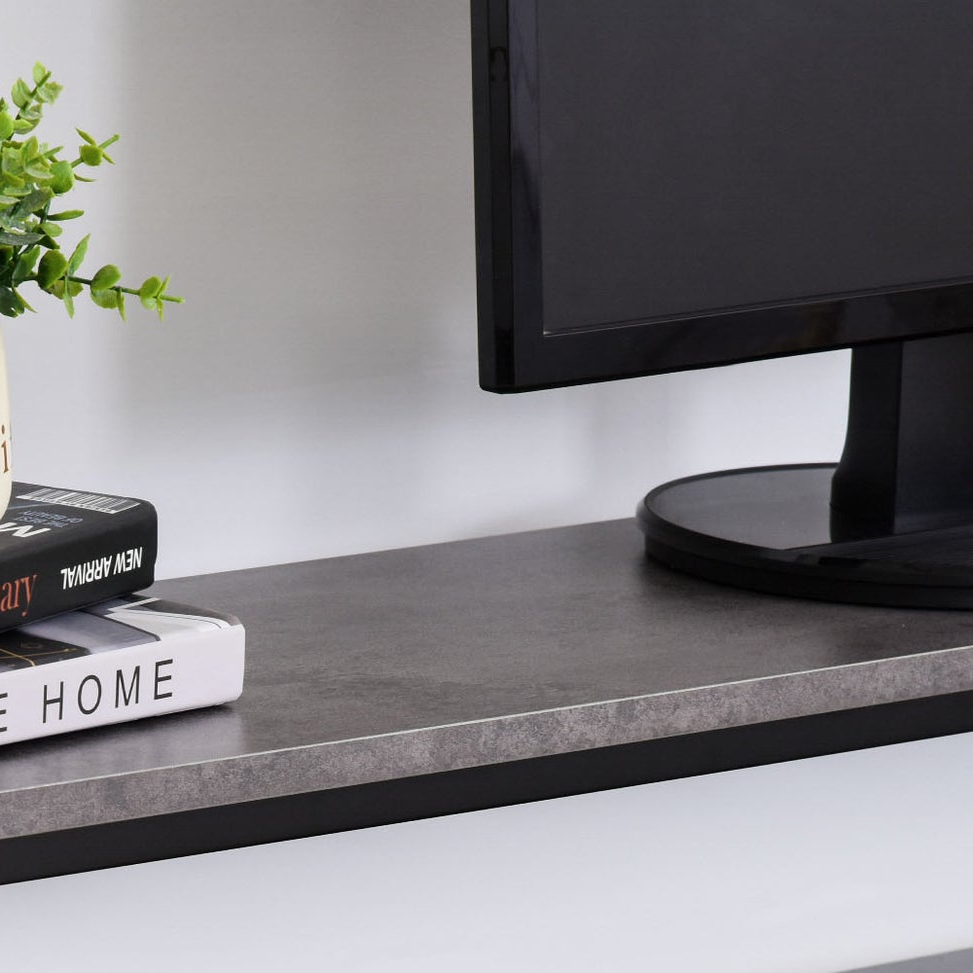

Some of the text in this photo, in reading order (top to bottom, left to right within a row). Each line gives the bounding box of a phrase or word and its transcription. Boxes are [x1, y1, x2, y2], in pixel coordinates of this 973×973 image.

[60, 547, 143, 590] NEW ARRIVAL
[41, 658, 175, 725] HOME
